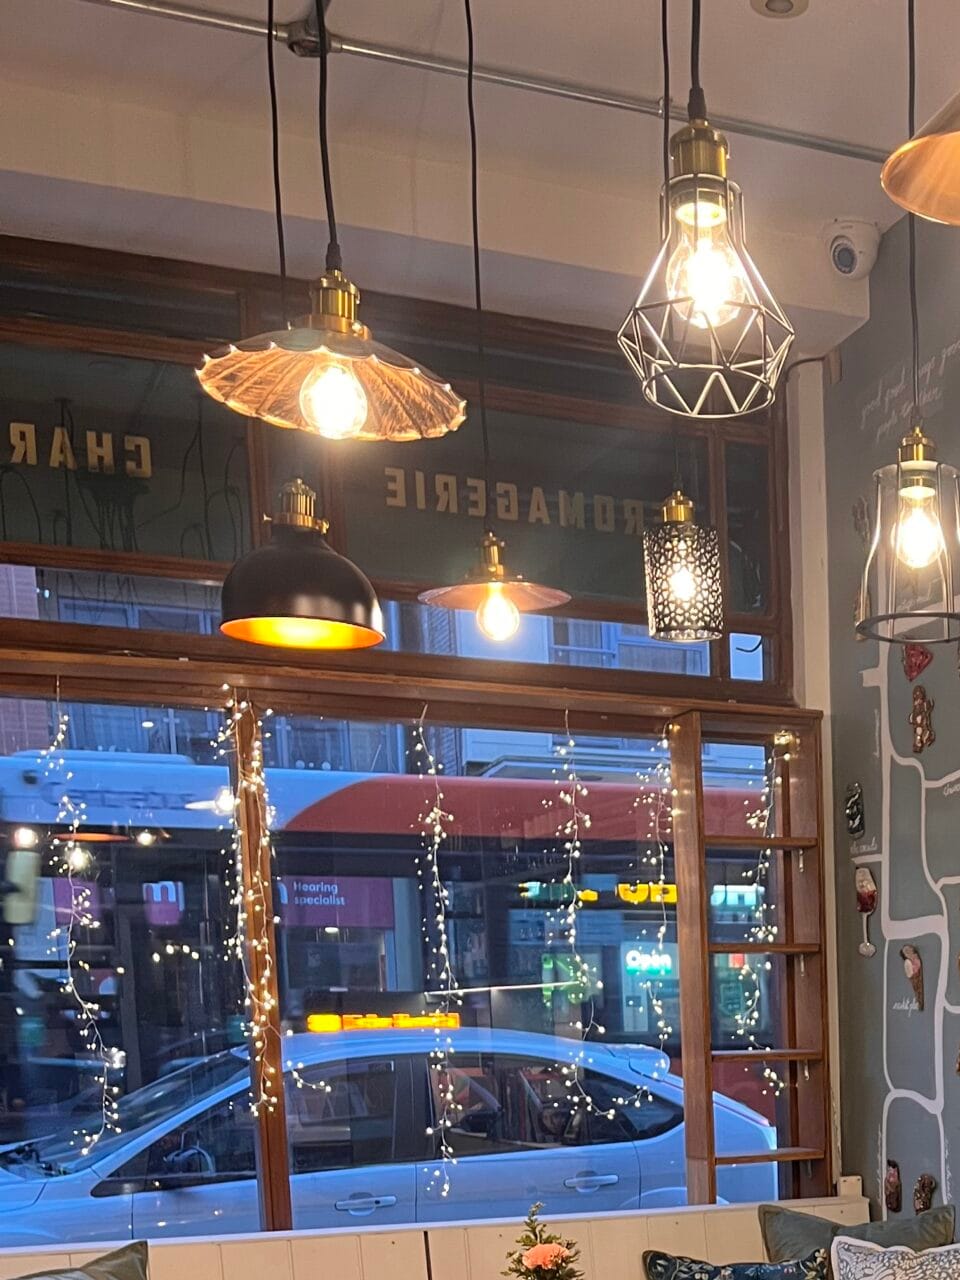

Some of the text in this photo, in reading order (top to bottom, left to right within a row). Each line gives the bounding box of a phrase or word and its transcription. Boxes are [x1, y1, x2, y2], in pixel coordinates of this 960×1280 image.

[293, 881, 338, 894] Hearing
[293, 894, 345, 906] specialist
[625, 950, 672, 974] Open
